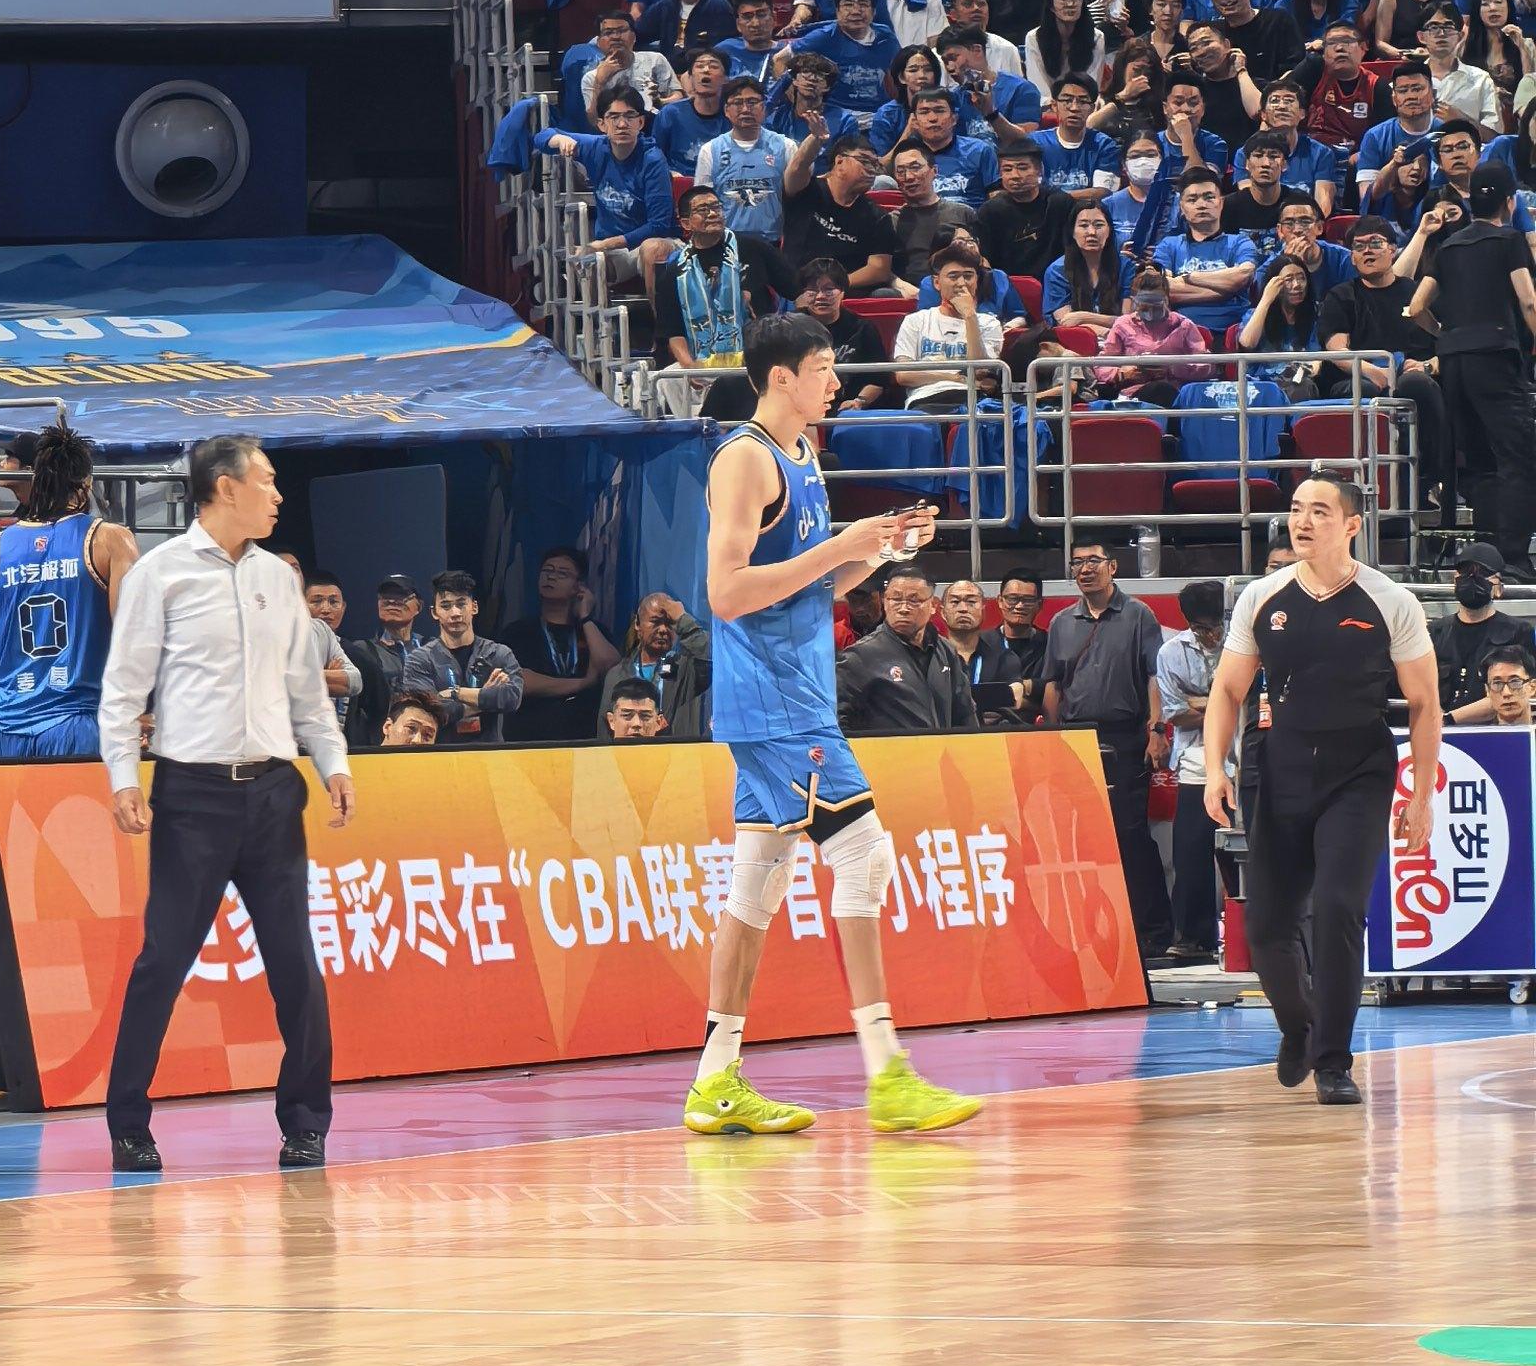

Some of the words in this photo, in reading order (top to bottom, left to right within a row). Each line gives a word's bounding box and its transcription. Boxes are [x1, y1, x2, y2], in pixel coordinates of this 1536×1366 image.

[17, 592, 70, 660] 0
[1448, 778, 1490, 903] 百岁山
